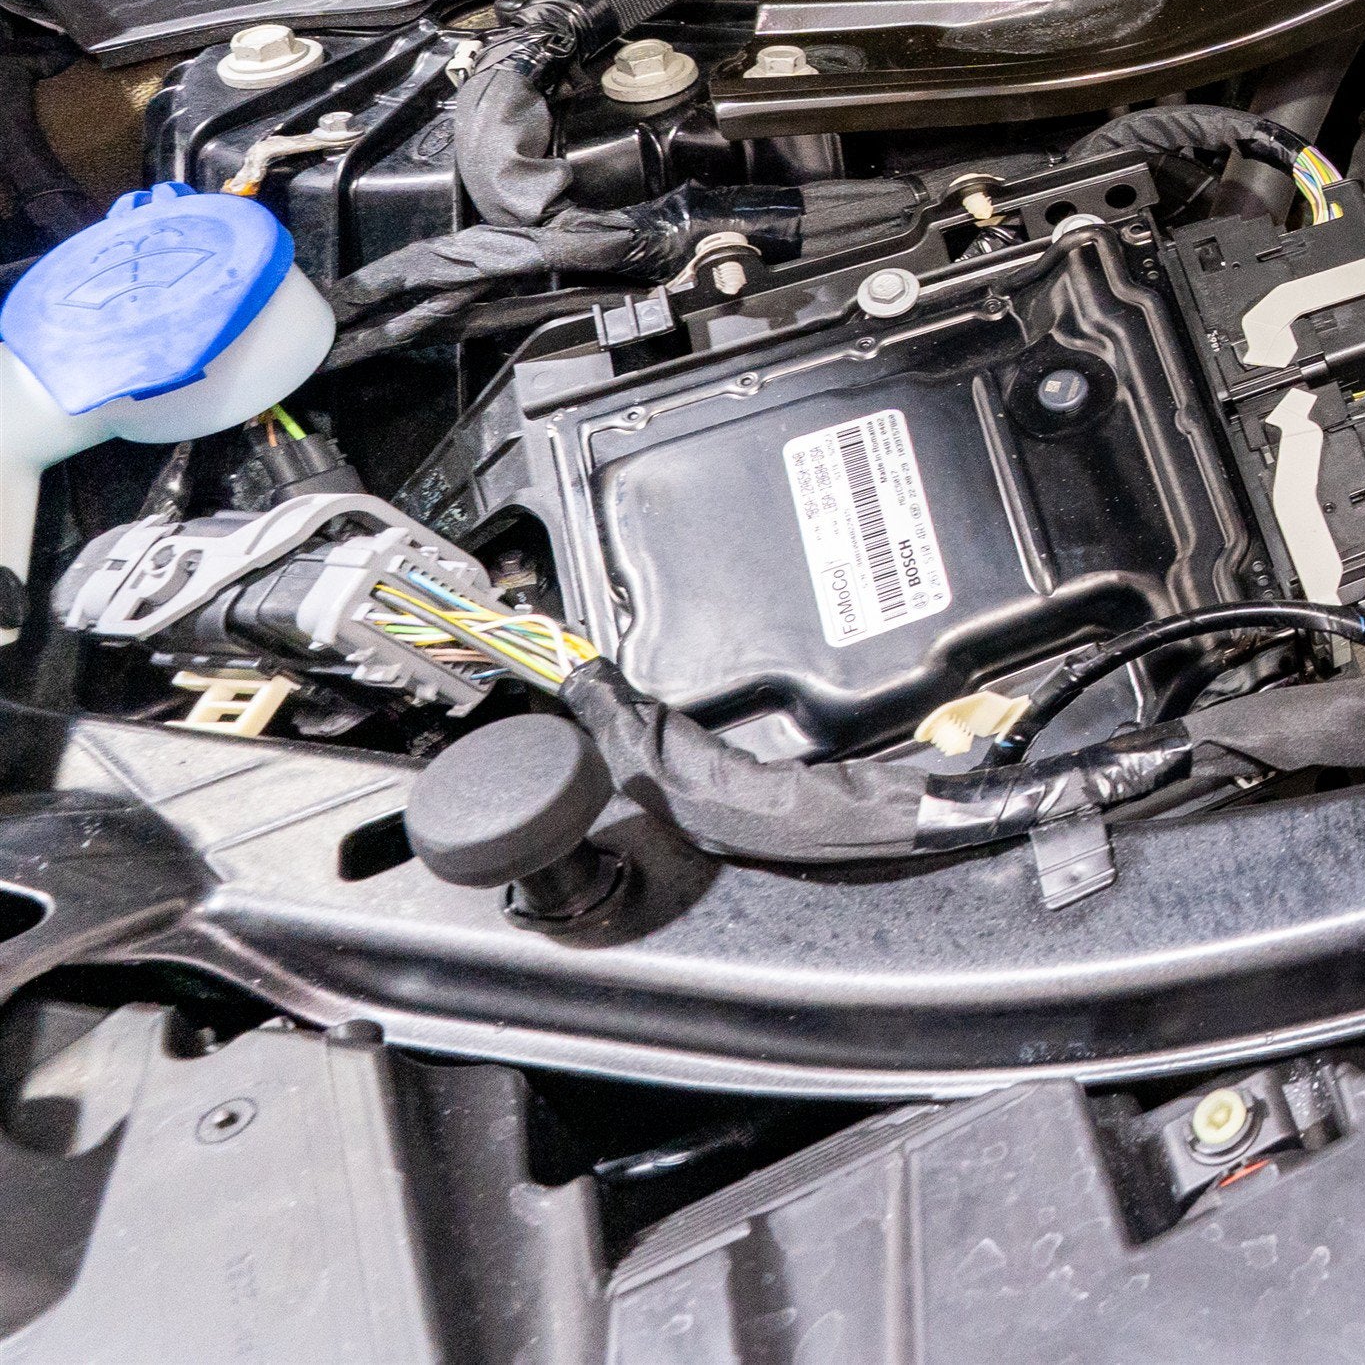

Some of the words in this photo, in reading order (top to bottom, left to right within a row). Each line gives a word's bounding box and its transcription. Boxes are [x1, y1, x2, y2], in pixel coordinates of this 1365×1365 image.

[865, 420, 880, 453] Romania
[875, 461, 888, 484] Made
[897, 537, 921, 588] BOSCH
[828, 567, 859, 635] FoMoCo
